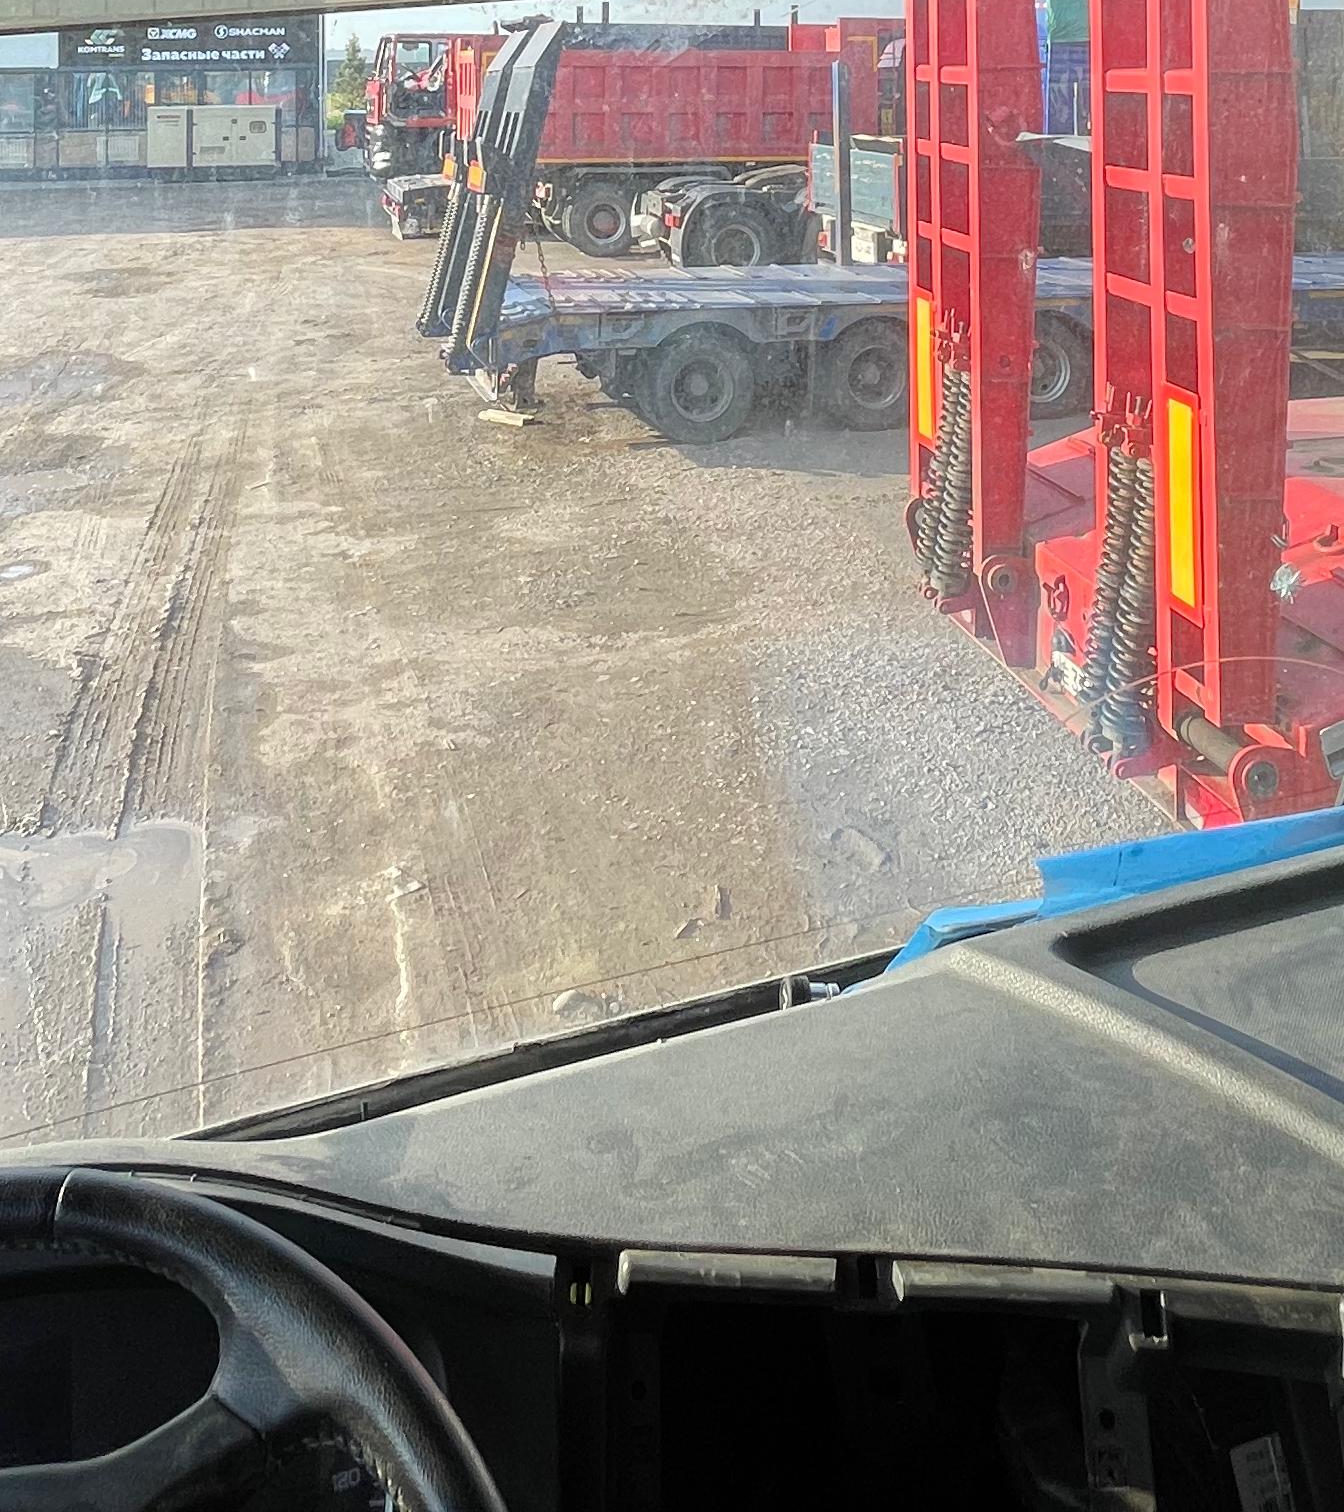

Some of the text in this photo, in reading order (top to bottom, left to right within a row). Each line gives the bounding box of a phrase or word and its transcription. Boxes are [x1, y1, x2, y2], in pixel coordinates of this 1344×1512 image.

[160, 28, 198, 40] XCMG
[228, 26, 285, 37] SHACMAN
[141, 48, 265, 61] Запасные части
